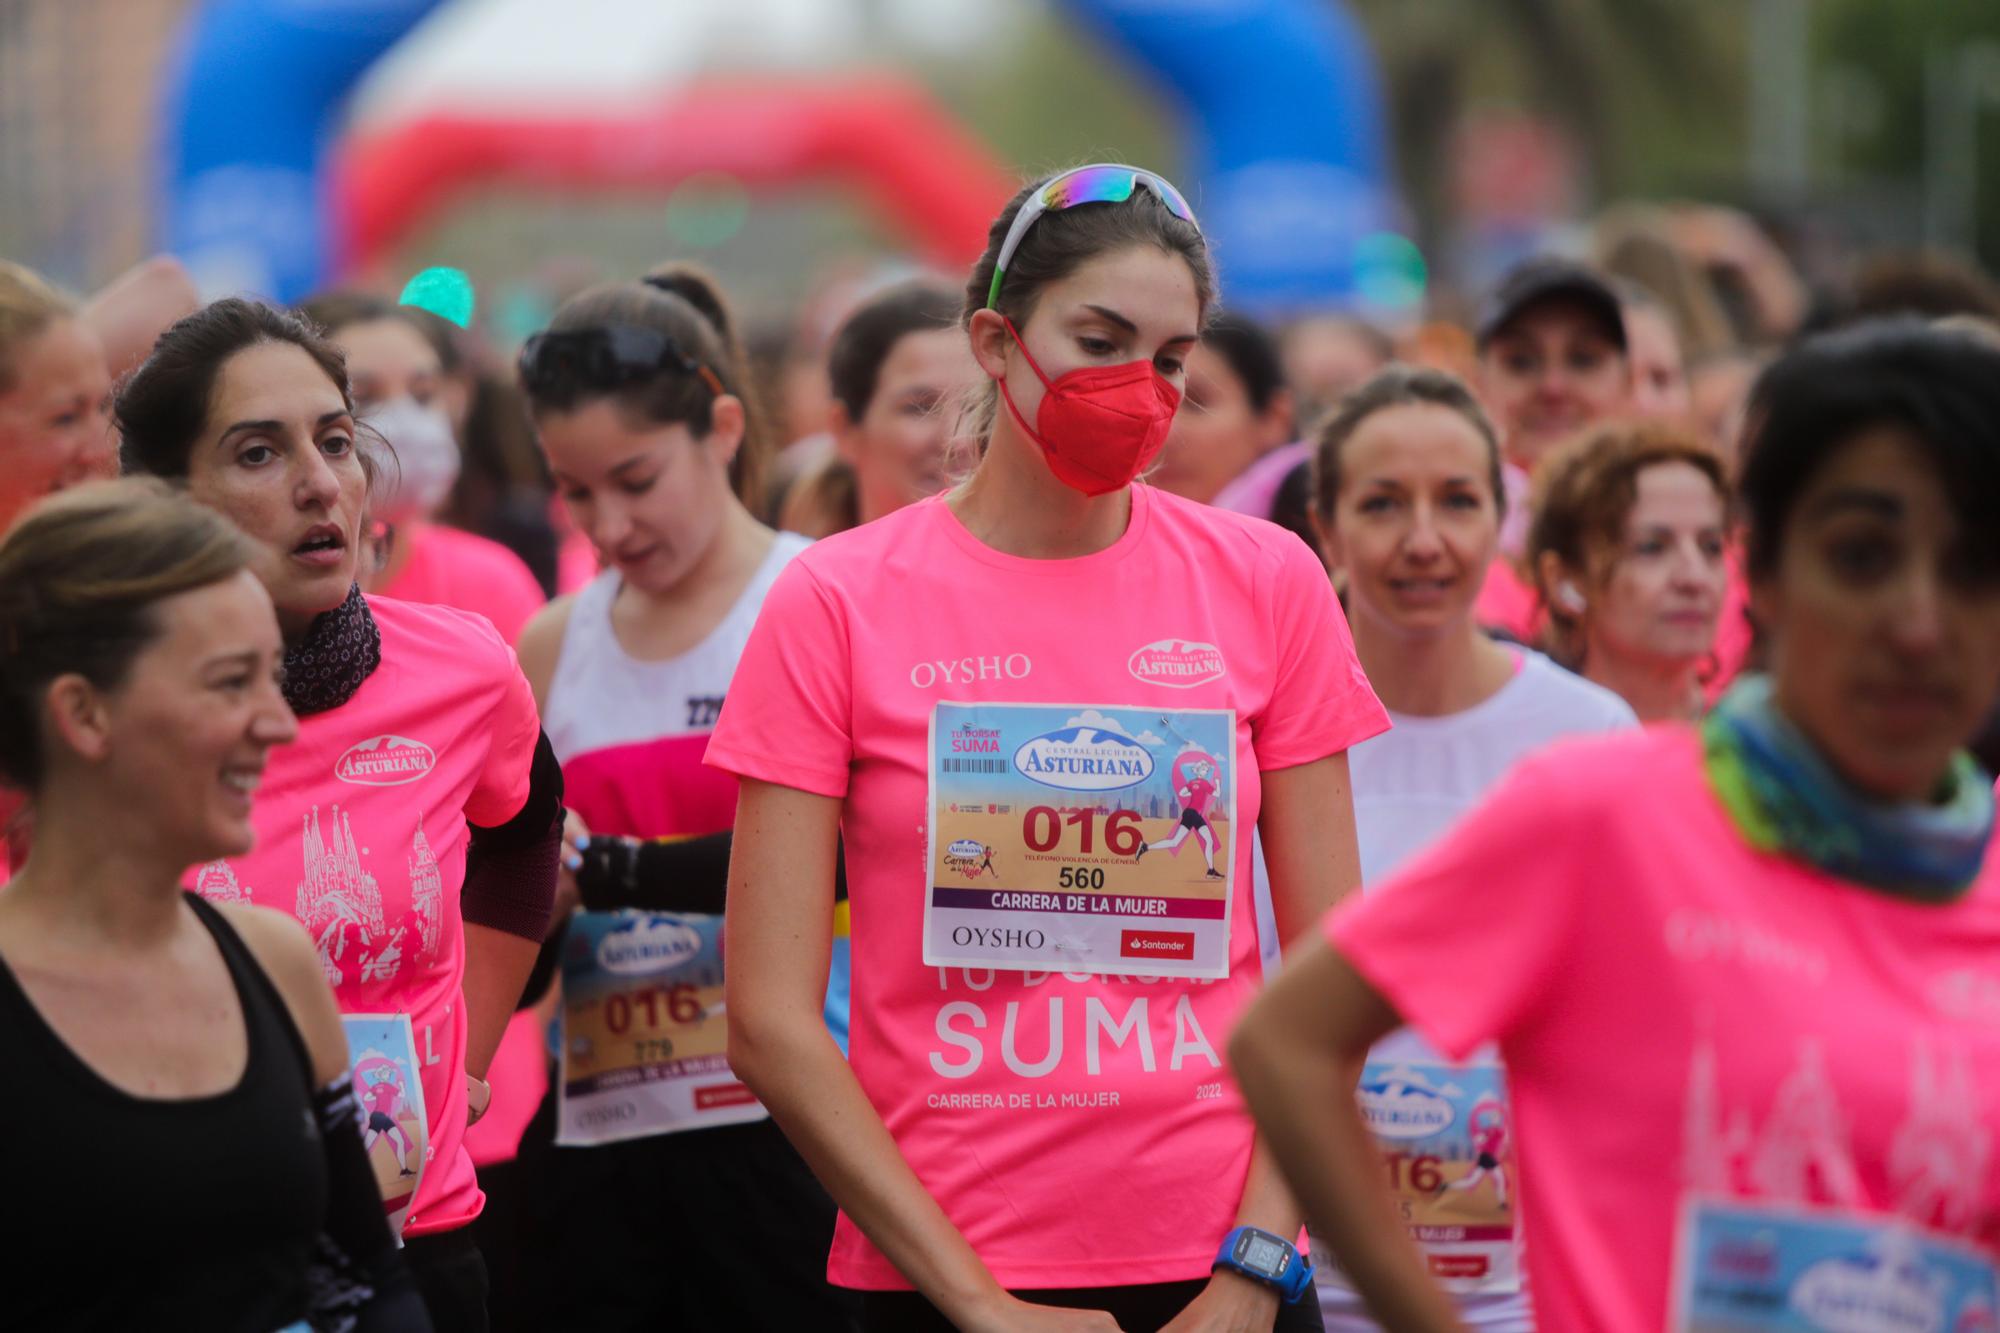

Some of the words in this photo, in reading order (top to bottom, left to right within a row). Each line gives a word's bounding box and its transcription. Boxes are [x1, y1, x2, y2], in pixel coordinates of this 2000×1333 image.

[910, 653, 1032, 689] OYSHO
[951, 739, 1001, 753] SUMA
[1045, 747, 1090, 755] CENTRAL
[1022, 805, 1144, 856] 016
[1058, 866, 1105, 890] 560
[991, 892, 1061, 910] CARRERA
[1066, 895, 1086, 911] DE
[1091, 897, 1110, 913] LA
[1115, 898, 1168, 915] MUJER
[952, 926, 1045, 949] OYSHO
[1141, 939, 1185, 952] Santander
[604, 981, 703, 1036] 016
[928, 994, 1222, 1079] SUMA
[927, 1093, 1002, 1109] CARRERA
[1008, 1093, 1031, 1108] DE
[1037, 1092, 1056, 1108] LA
[1061, 1091, 1121, 1107] MUJER
[1196, 1083, 1222, 1100] 2022
[1384, 1152, 1443, 1193] 16
